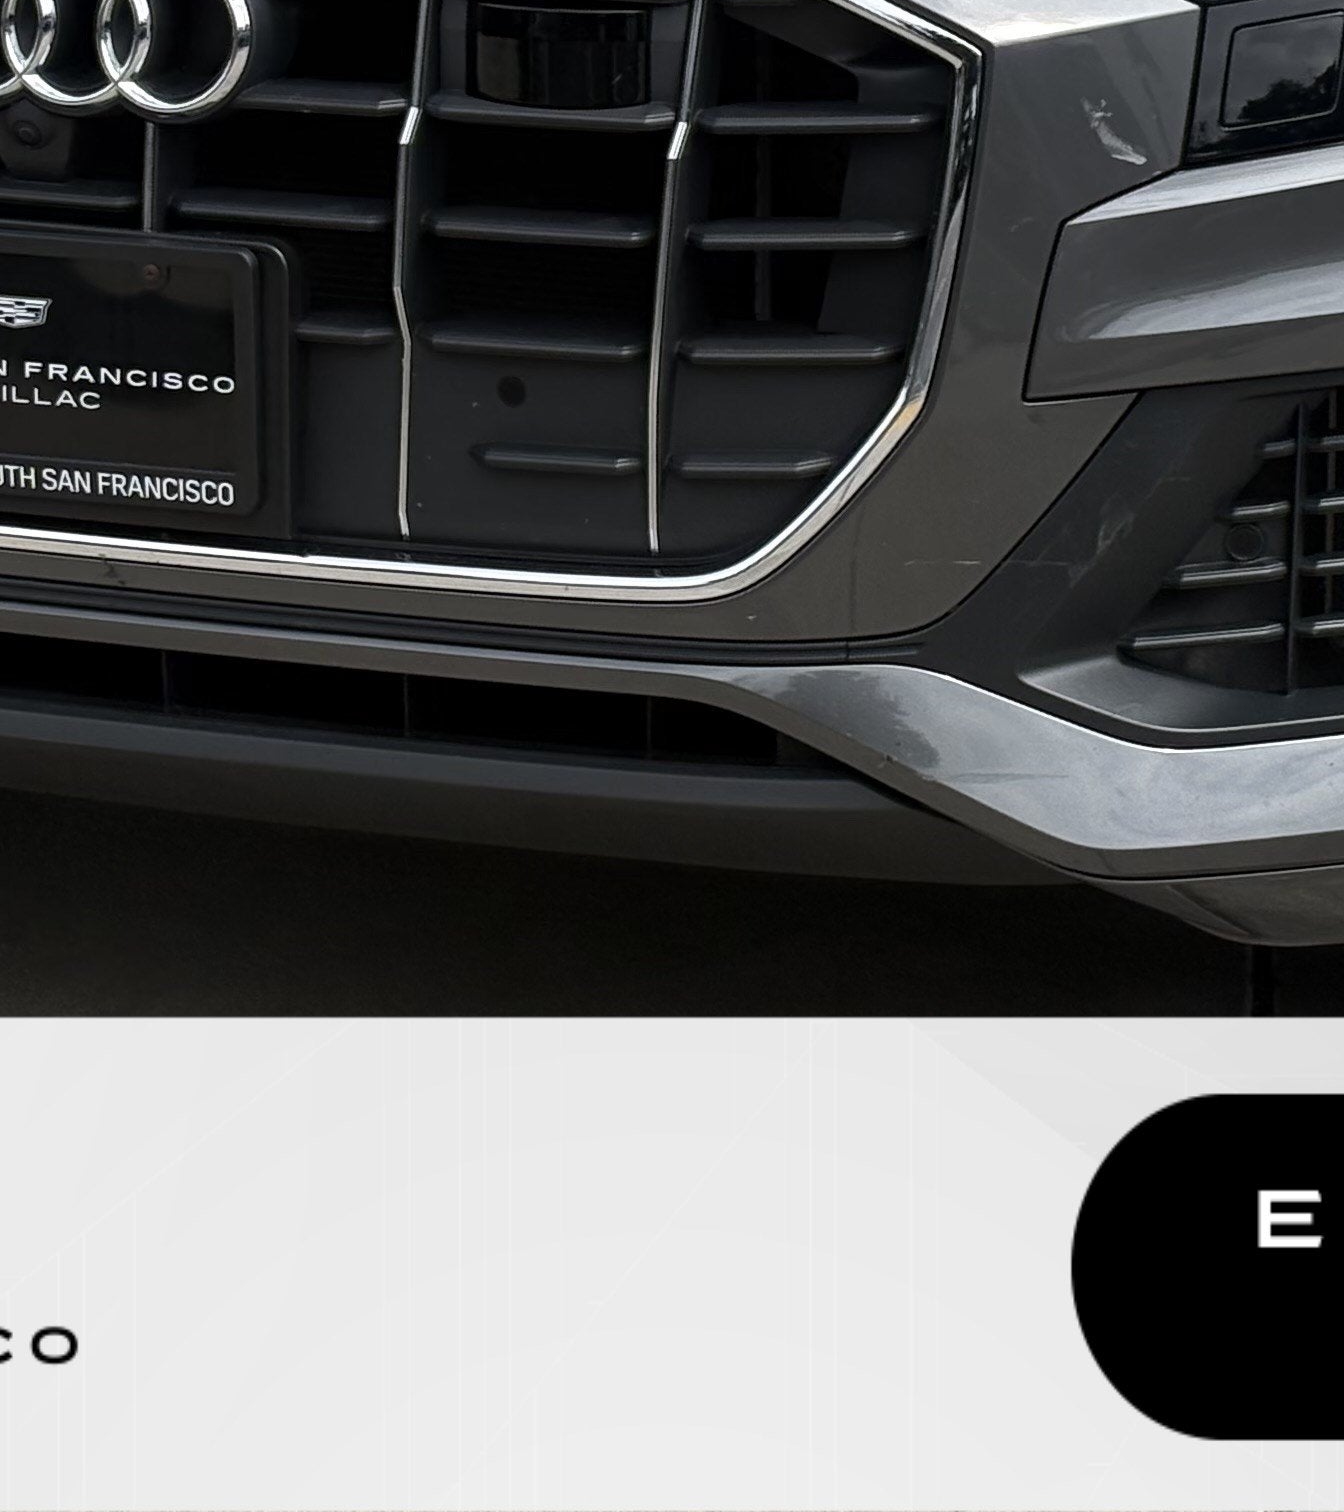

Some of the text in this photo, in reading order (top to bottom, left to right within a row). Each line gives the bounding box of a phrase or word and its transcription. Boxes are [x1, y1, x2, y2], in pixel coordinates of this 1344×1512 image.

[24, 361, 235, 394] FRANCISCO
[41, 467, 92, 494] SAN
[97, 472, 235, 506] FRANCISCO
